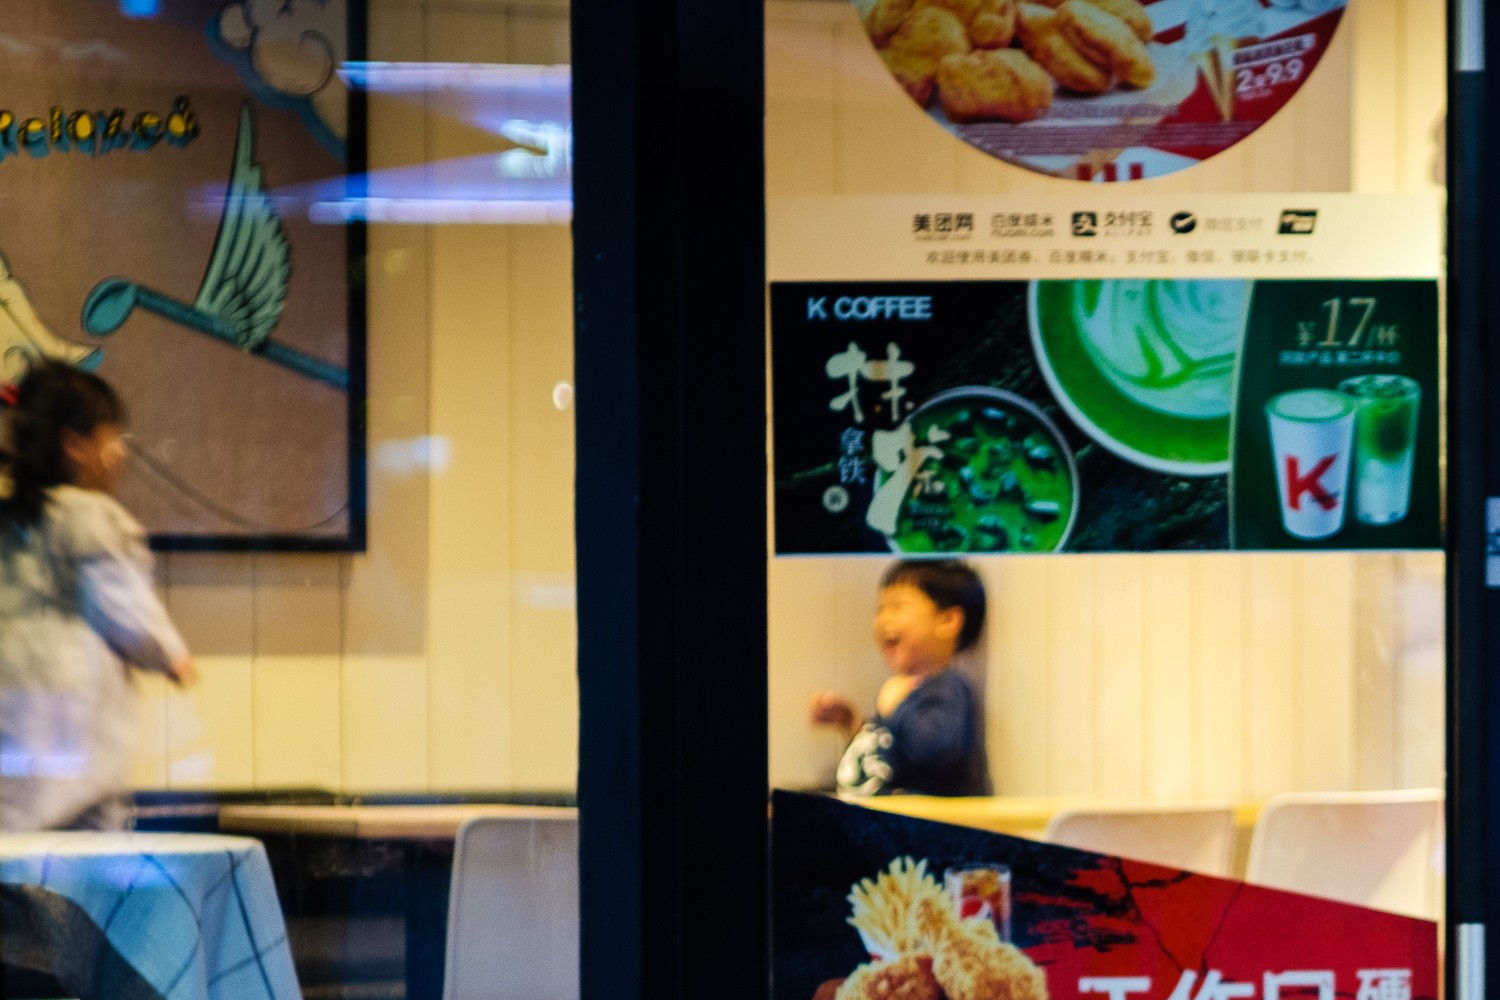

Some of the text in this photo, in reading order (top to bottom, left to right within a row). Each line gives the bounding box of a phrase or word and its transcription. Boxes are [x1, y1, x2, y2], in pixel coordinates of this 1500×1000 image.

[914, 213, 974, 232] 美团网
[807, 296, 933, 321] K COFFEE
